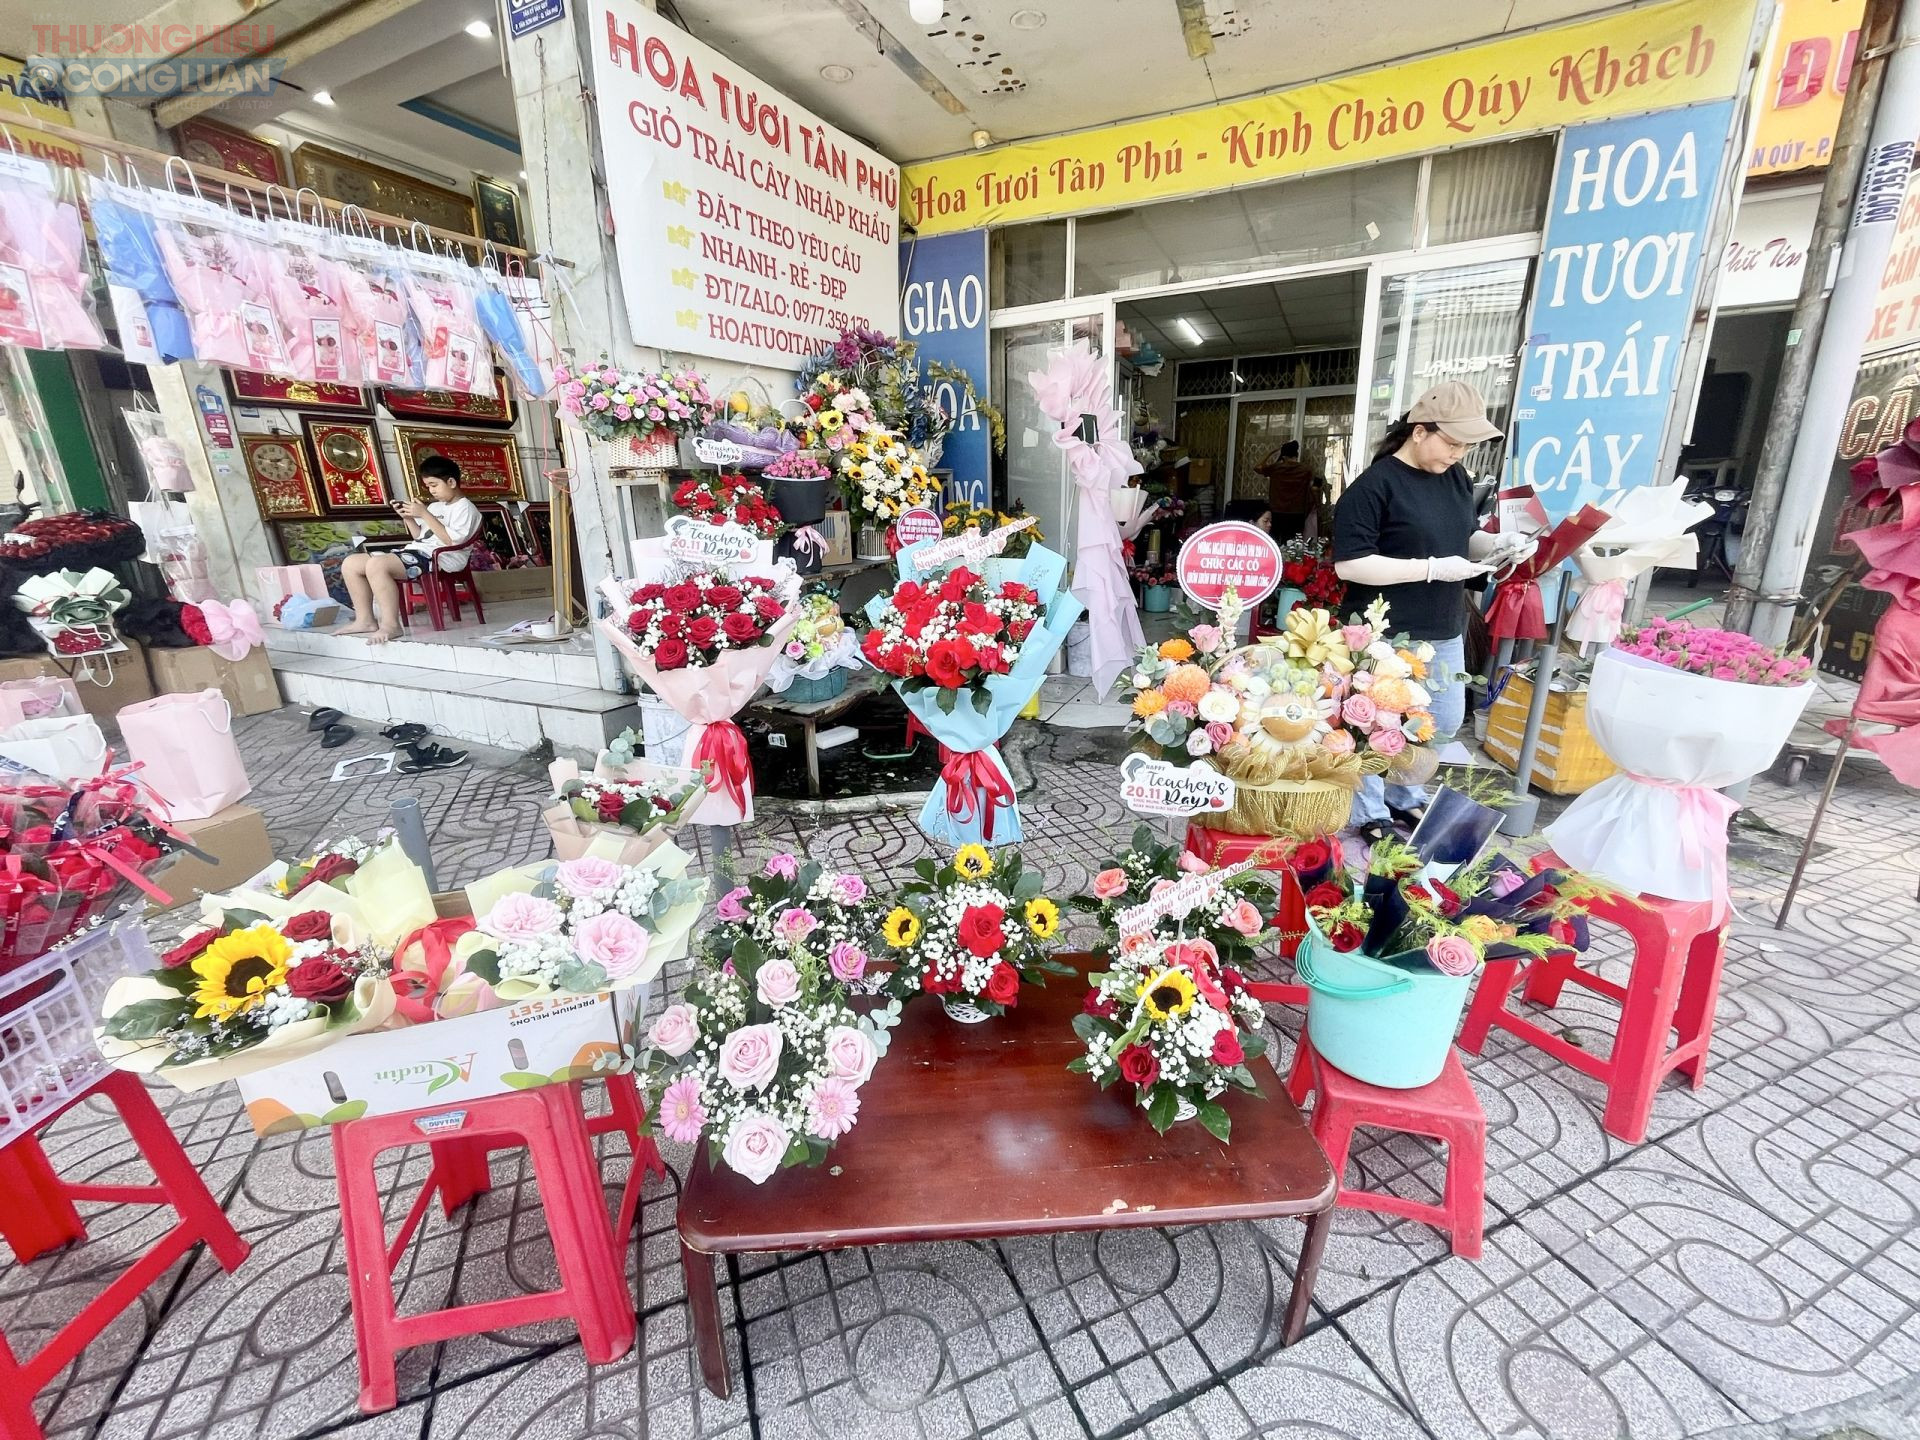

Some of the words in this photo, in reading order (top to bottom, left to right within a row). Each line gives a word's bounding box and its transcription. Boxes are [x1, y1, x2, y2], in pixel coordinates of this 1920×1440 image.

[606, 10, 708, 113] HOA
[712, 72, 791, 157] TƯƠI
[799, 124, 848, 188] TÂN
[856, 158, 898, 212] PHÚ
[911, 175, 967, 227] Hoa
[976, 166, 1038, 208] Tươi
[1049, 158, 1105, 195] Tân
[1116, 139, 1183, 183] Phú
[1221, 111, 1312, 169] Kính
[1327, 97, 1425, 151] Chào
[1549, 24, 1717, 106] Khách
[628, 100, 682, 149] GIỎ
[686, 124, 746, 182] TRÁI
[750, 159, 791, 201] CÂY
[795, 178, 845, 225] NHẬP
[848, 205, 891, 246] KHẨU
[1563, 131, 1699, 215] HOA
[697, 189, 742, 231] ĐẶT
[746, 209, 795, 250] THEO
[798, 230, 830, 263] YÊU
[832, 243, 862, 275] CẦU
[700, 231, 778, 281] NHANH
[789, 261, 810, 291] RẺ
[820, 273, 847, 303] ĐẸP
[1548, 230, 1696, 308] TƯƠI
[705, 273, 790, 319] ĐT/ZALO:
[903, 274, 983, 336] GIAO
[1865, 300, 1904, 343] XE
[1534, 319, 1671, 402] TRÁI
[1523, 417, 1644, 493] CÂY
[671, 537, 700, 550] 20.11
[703, 541, 739, 561] Day
[690, 527, 755, 549] Teacher's
[1200, 556, 1225, 570] CHÚC
[1226, 557, 1245, 571] CÁC
[1246, 558, 1260, 572] CÔ
[1146, 764, 1166, 772] HAPPY
[1147, 771, 1229, 796] Teacher's
[1126, 785, 1161, 800] 20.11
[1161, 789, 1210, 811] Day
[1229, 859, 1254, 876] Nam
[508, 1002, 545, 1020] SET
[510, 1012, 550, 1027] MELONS
[552, 998, 595, 1017] PREMIUM
